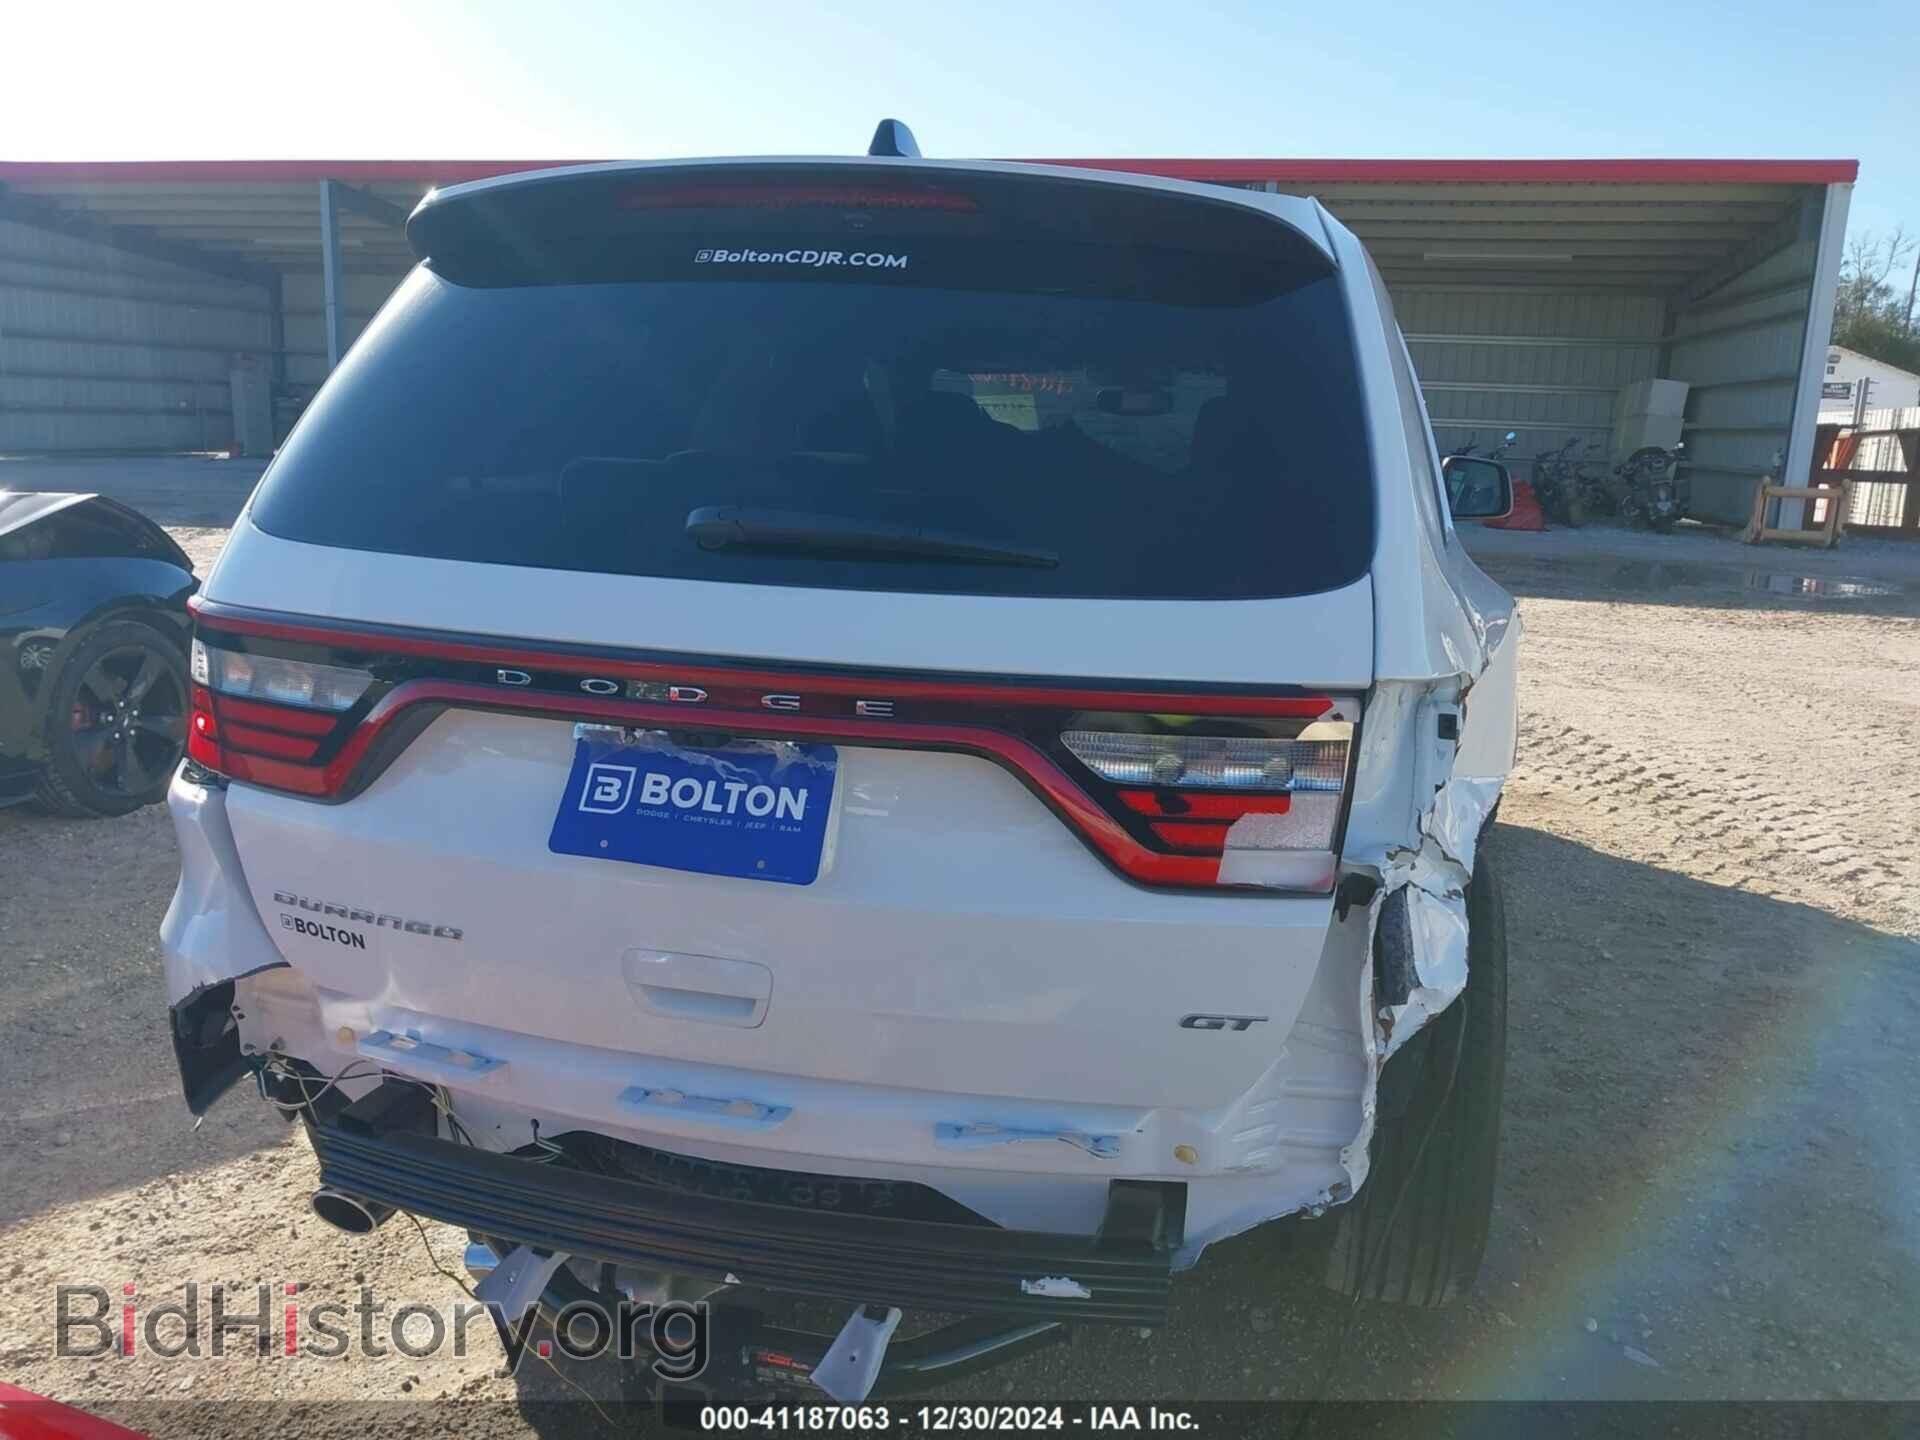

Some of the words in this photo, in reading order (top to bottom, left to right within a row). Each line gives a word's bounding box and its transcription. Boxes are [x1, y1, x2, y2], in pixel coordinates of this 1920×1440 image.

[712, 249, 908, 269] BoltonCDJR.COM
[495, 669, 895, 718] DODGE
[640, 772, 808, 821] BOLTON
[636, 808, 670, 819] DODGE
[779, 825, 802, 833] RAM
[273, 889, 465, 940] DURANGO
[294, 917, 366, 950] BOLTON
[1180, 1013, 1270, 1032] GT
